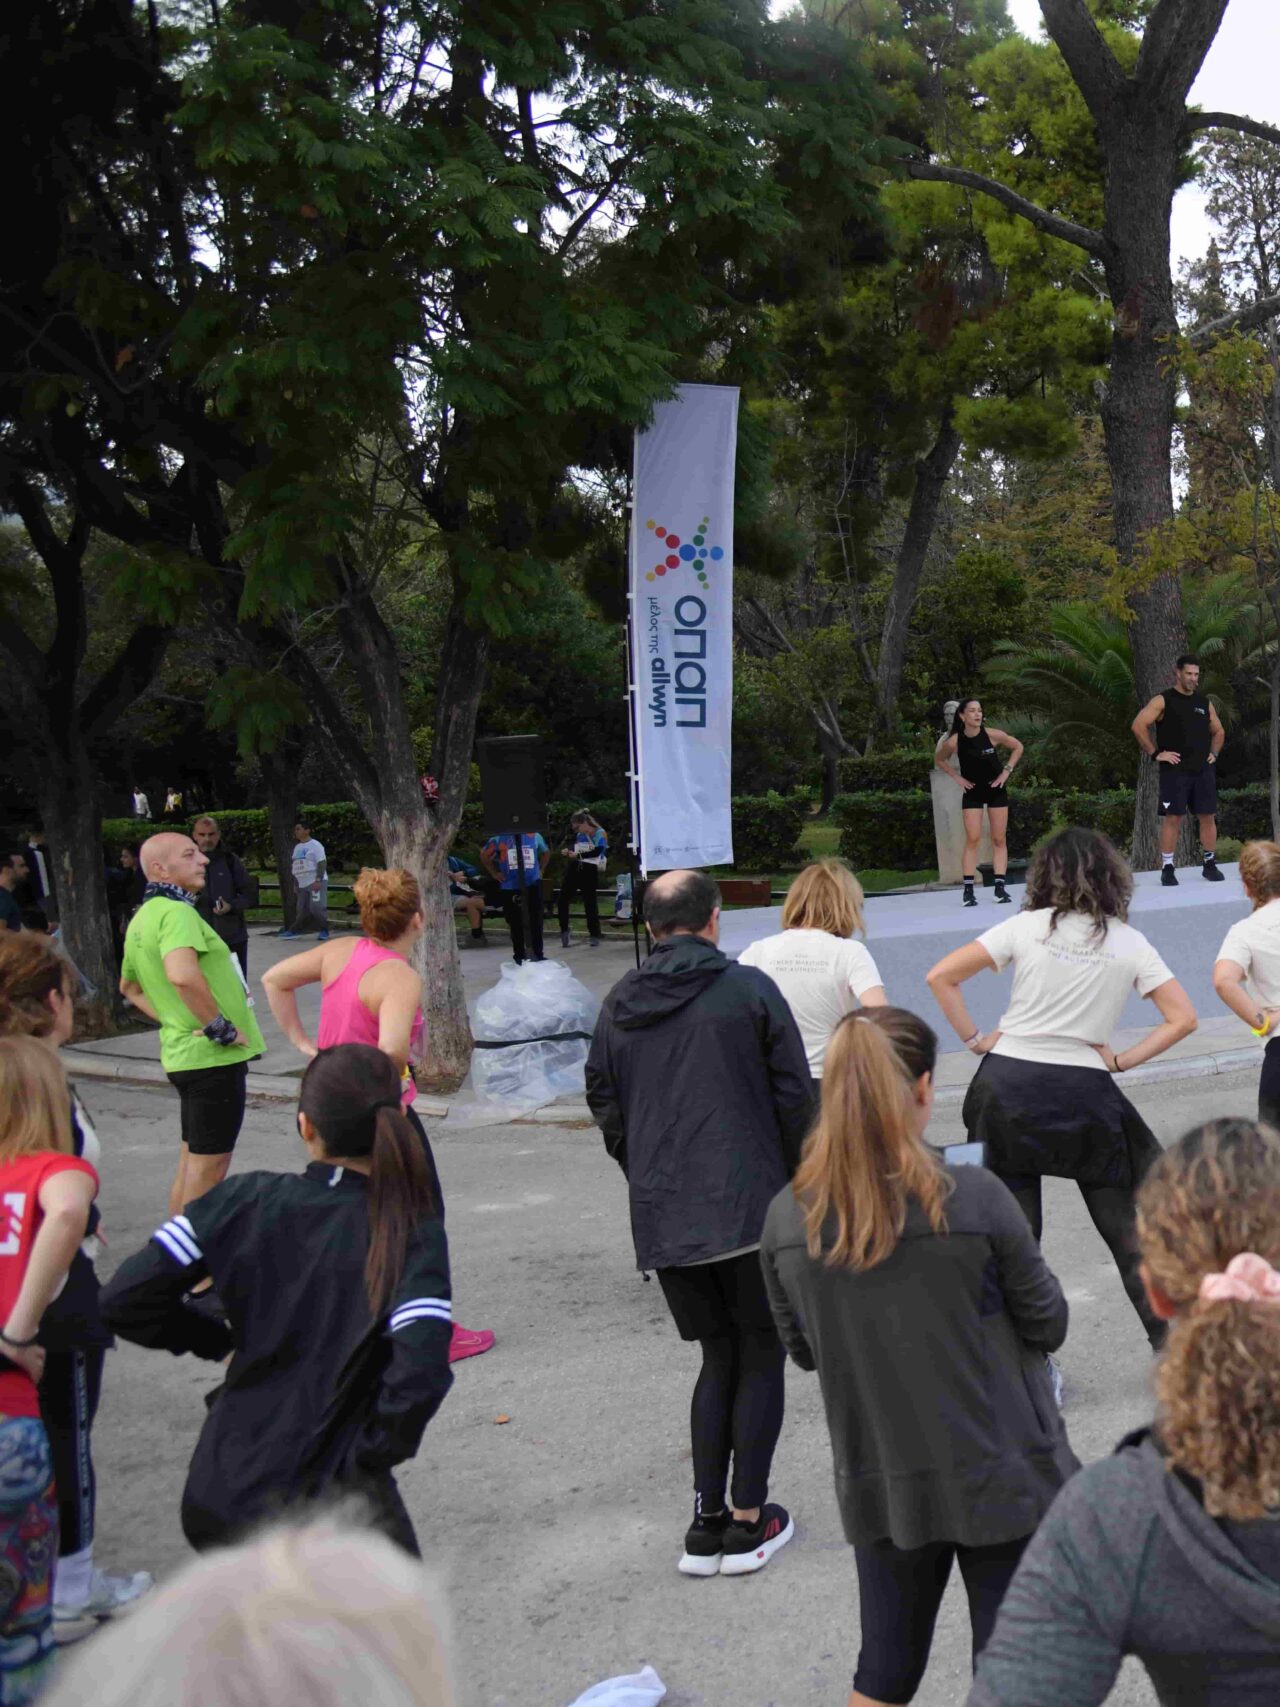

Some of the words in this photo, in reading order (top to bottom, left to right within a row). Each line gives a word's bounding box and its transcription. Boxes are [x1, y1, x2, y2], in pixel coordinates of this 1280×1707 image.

[647, 597, 661, 632] μέλος
[647, 635, 660, 654] της
[648, 657, 671, 727] allwyn
